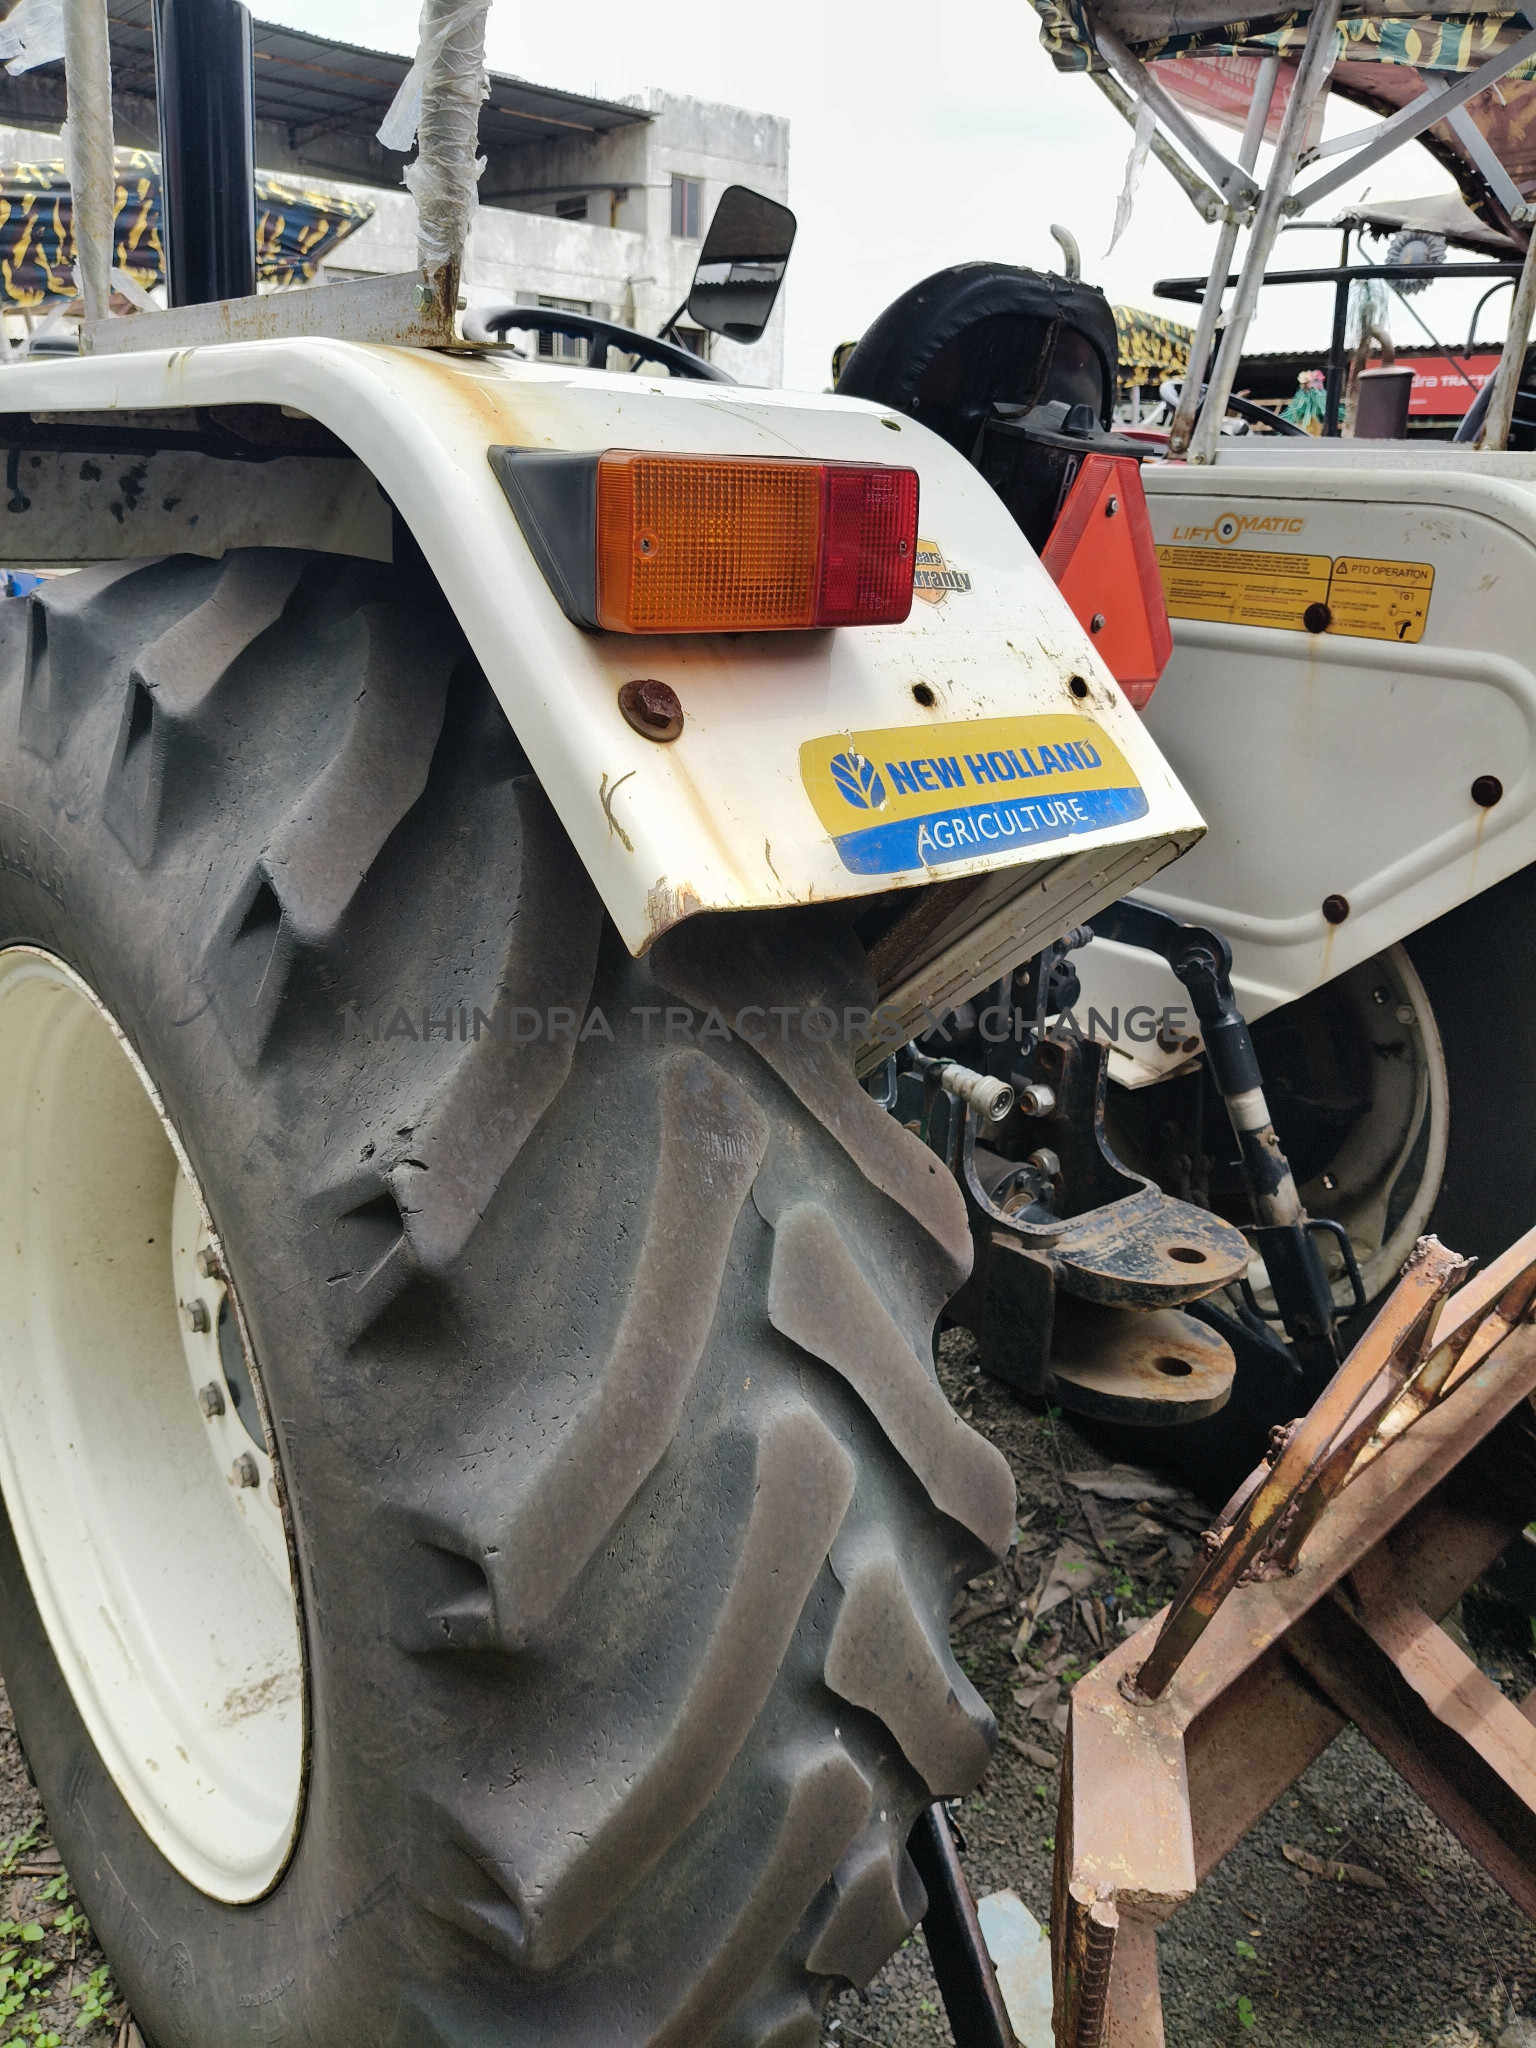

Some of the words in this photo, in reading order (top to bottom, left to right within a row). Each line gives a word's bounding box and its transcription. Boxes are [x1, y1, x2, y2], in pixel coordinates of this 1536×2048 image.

[915, 551, 942, 565] ears
[913, 570, 972, 593] rranty
[1351, 564, 1370, 575] PTO
[1372, 566, 1428, 580] OPERATION
[885, 756, 967, 796] NEW
[963, 740, 1102, 785] HOLLAND
[919, 798, 1089, 851] AGRICULTURE
